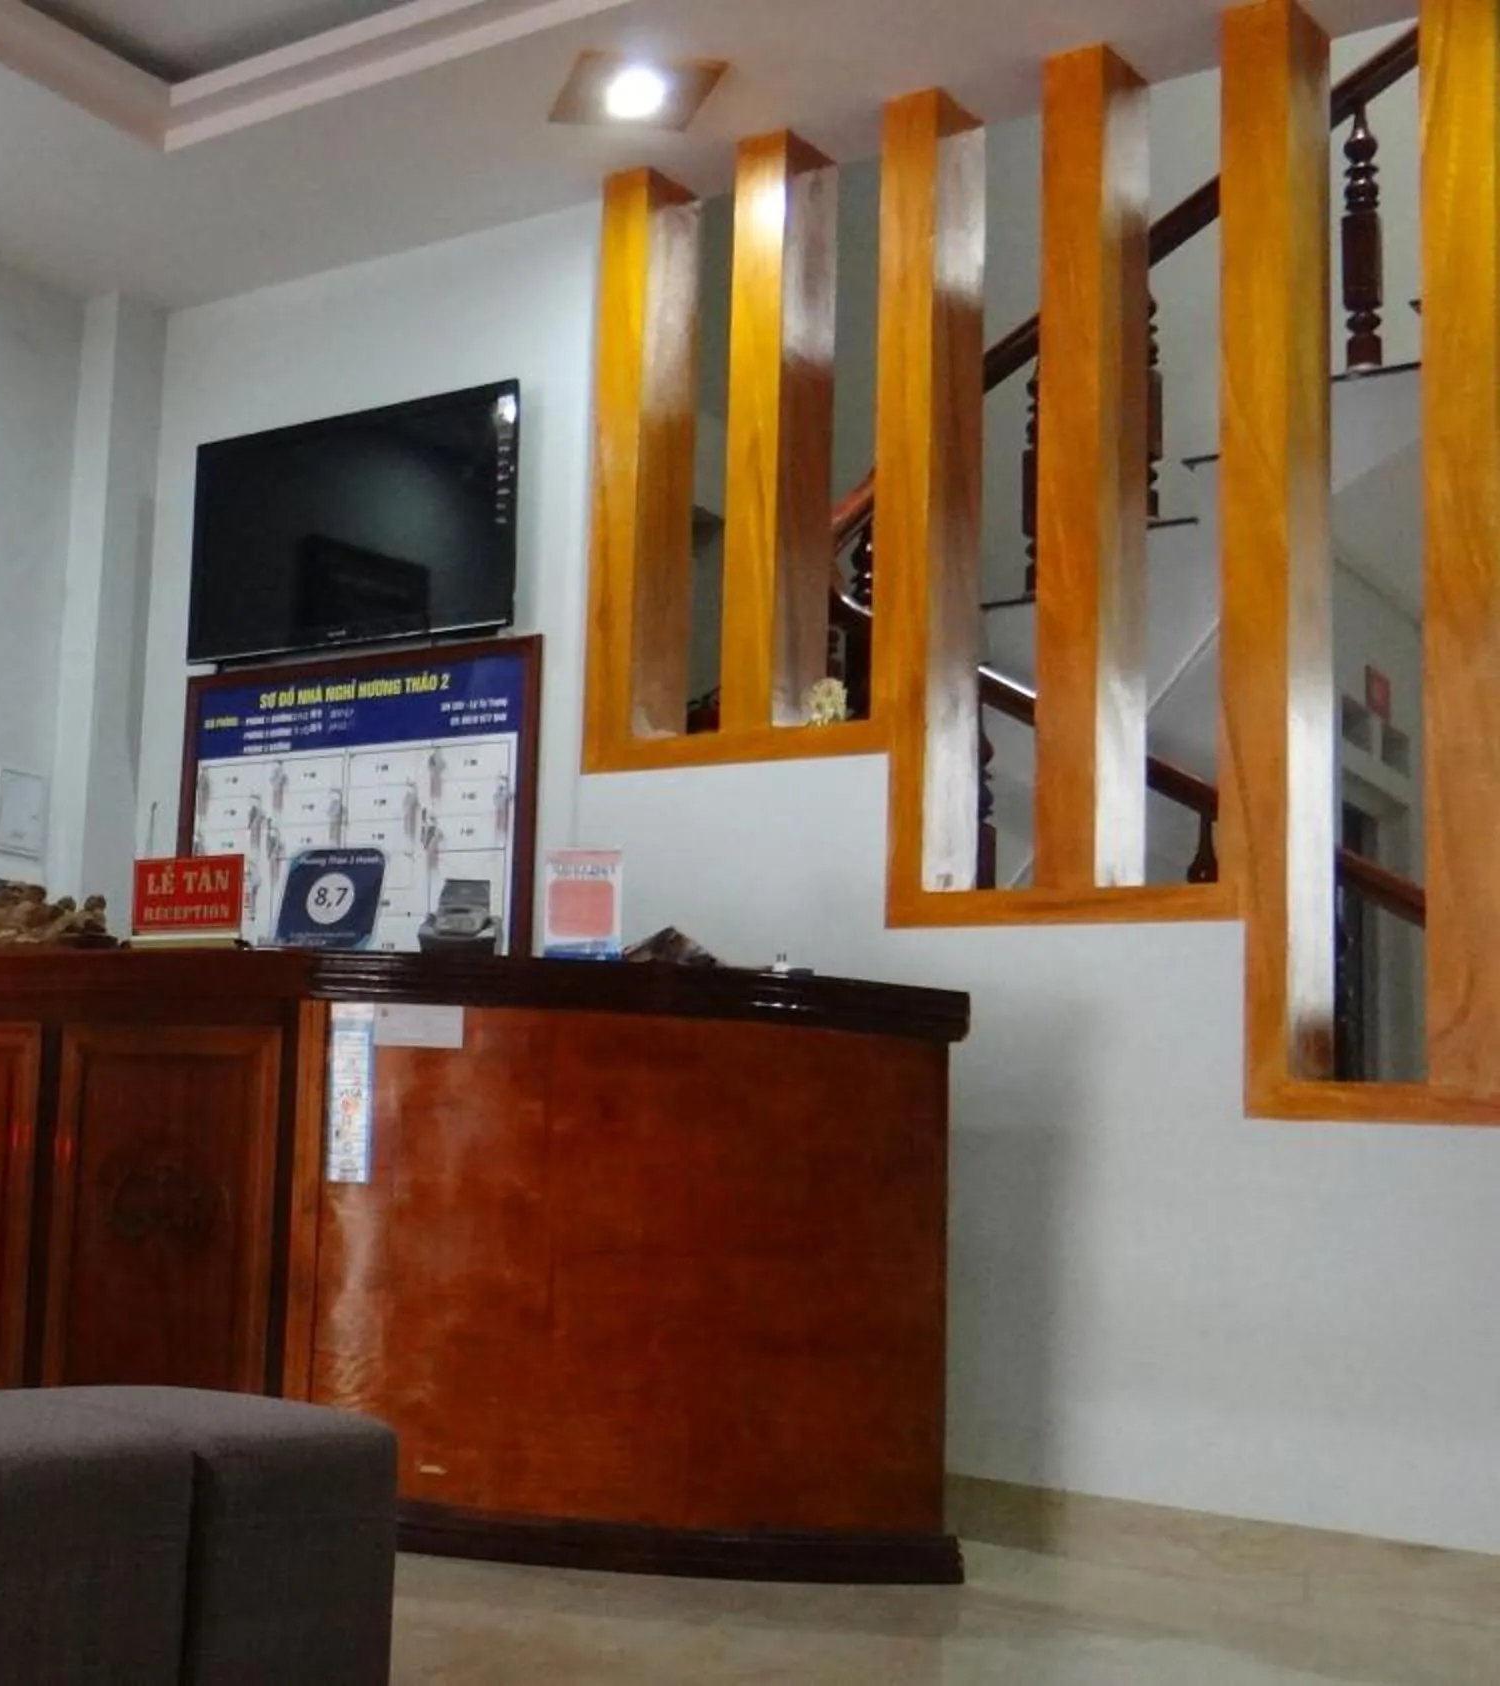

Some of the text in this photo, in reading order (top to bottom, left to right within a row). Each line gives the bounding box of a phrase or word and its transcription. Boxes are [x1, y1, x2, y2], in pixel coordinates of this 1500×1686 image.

[440, 673, 450, 690] 2
[183, 866, 229, 894] TÂN
[314, 886, 348, 909] 8,7
[143, 904, 229, 922] RECEPTION
